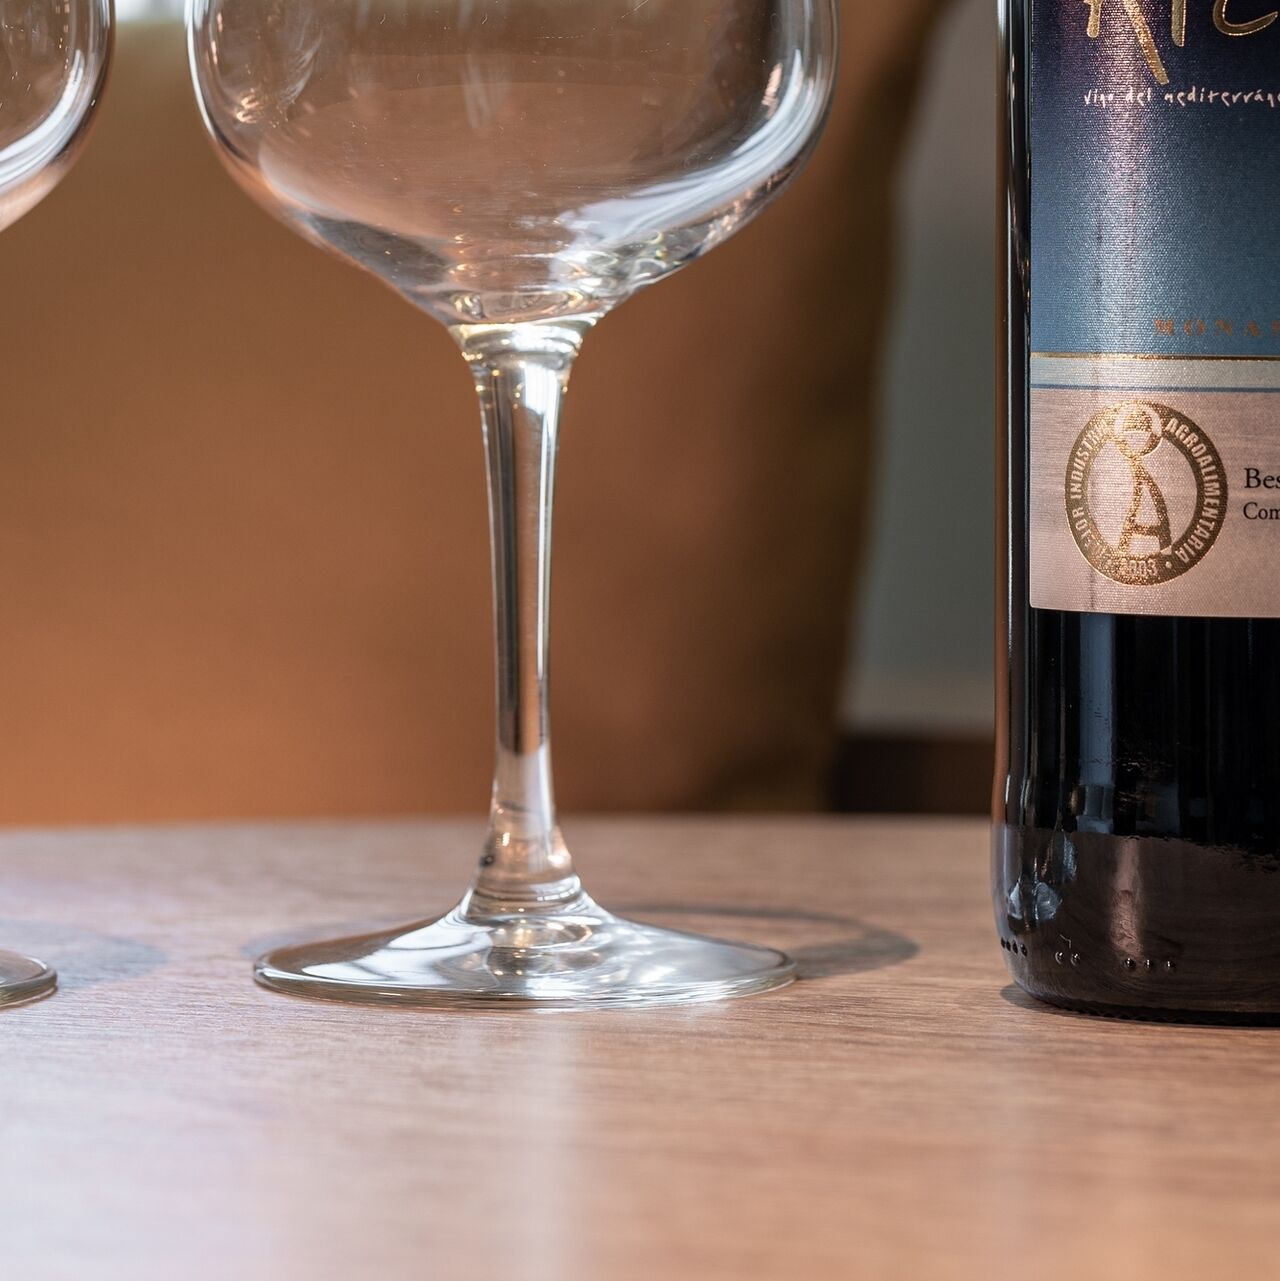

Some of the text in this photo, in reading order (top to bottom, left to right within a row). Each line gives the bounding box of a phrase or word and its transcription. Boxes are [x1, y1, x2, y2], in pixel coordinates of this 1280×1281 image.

[1084, 87, 1114, 108] vino
[1125, 86, 1152, 106] del
[1166, 418, 1221, 564] AGROALIMENTARIA
